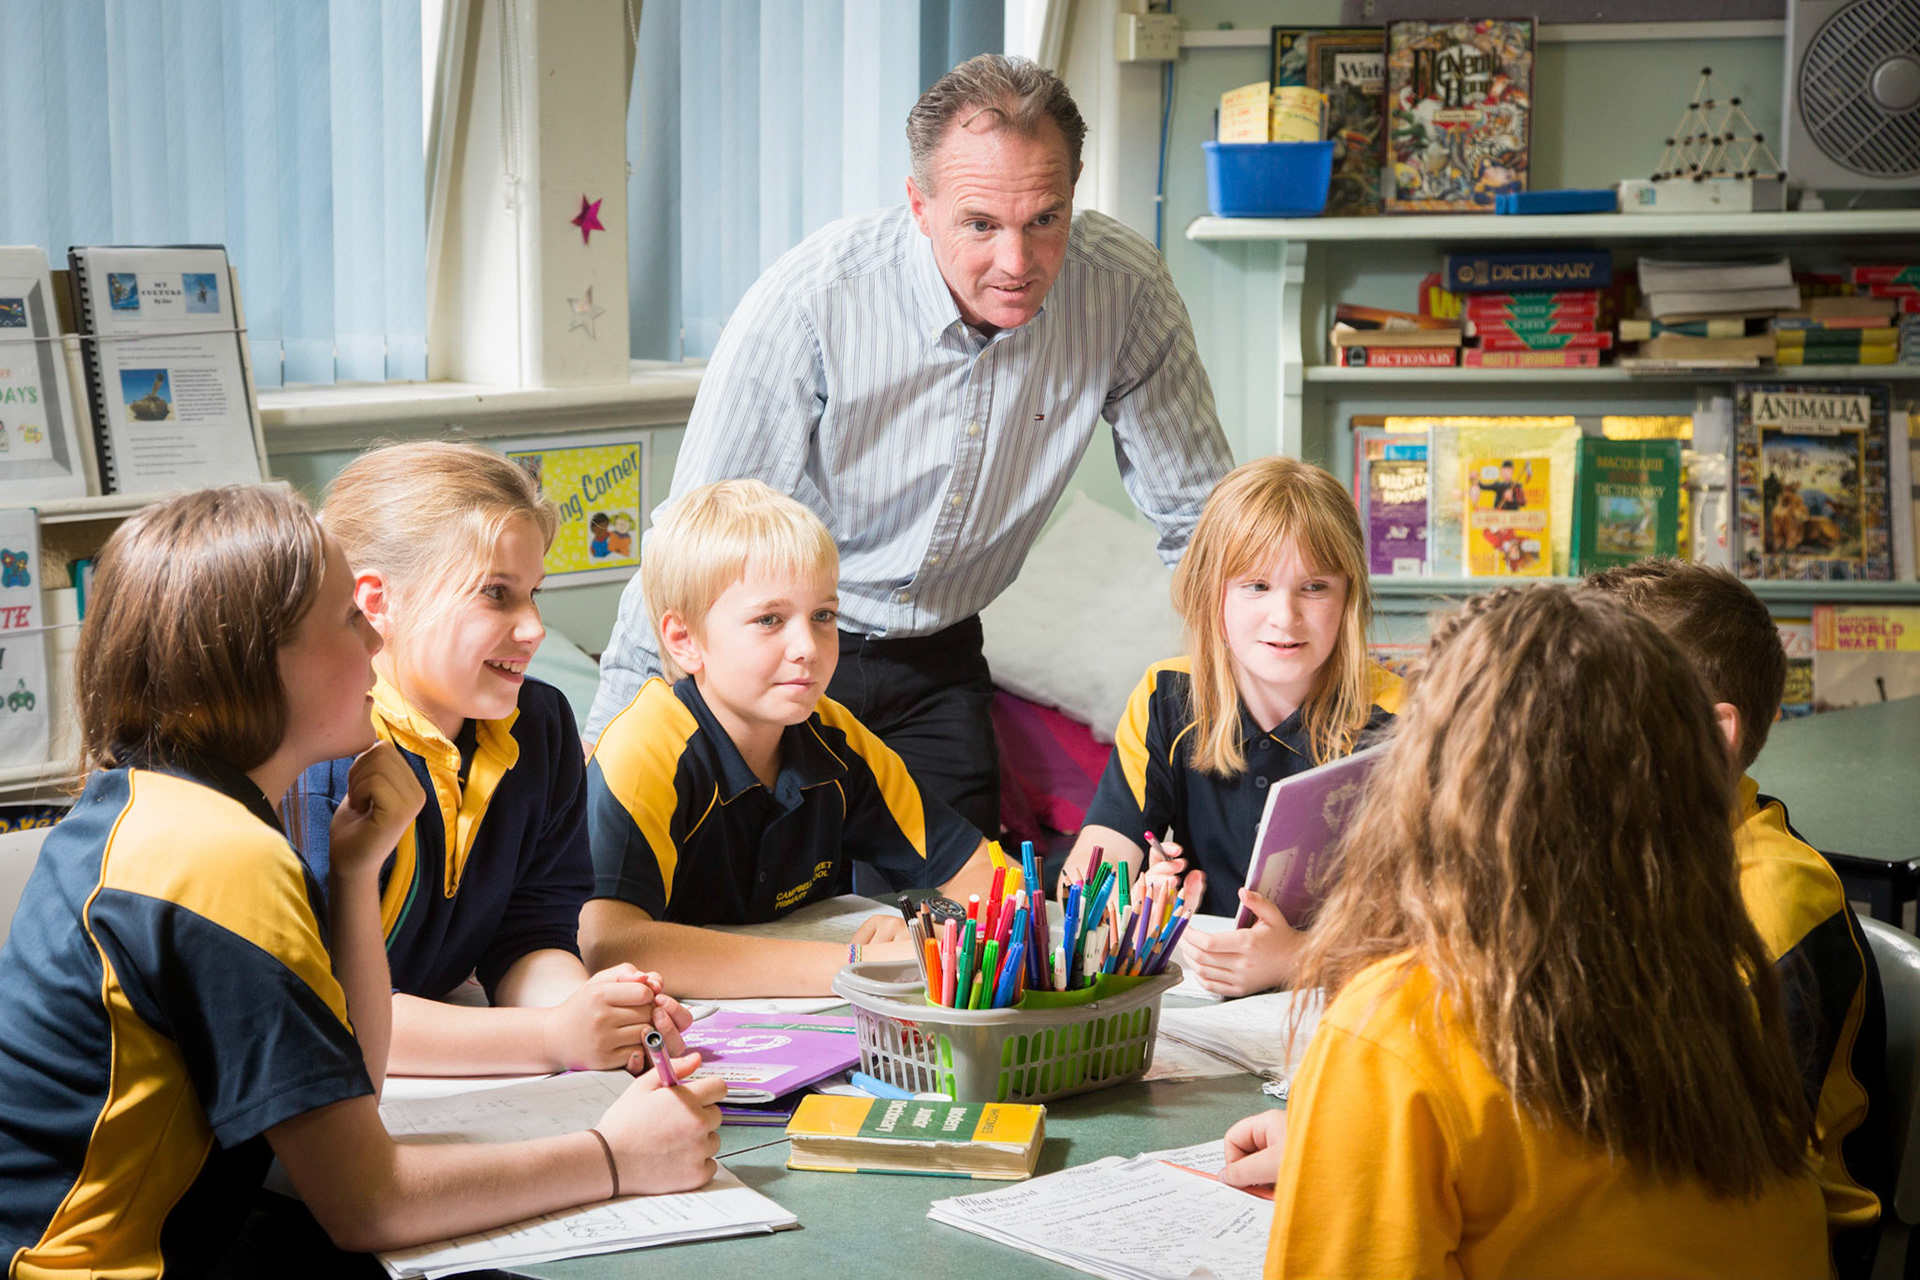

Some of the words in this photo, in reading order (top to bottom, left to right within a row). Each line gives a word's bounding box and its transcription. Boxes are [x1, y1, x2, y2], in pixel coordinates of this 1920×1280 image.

[1491, 262, 1595, 282] DICTIONARY
[1757, 396, 1866, 423] ANIMALIA
[582, 451, 636, 501] Corner
[1594, 483, 1667, 498] DICTIONARY
[1838, 622, 1905, 638] WORLD
[1838, 637, 1879, 650] WAR
[875, 1099, 908, 1132] Dictionary
[911, 1107, 935, 1128] Junior
[942, 1107, 967, 1131] Modern
[955, 1197, 994, 1207] What
